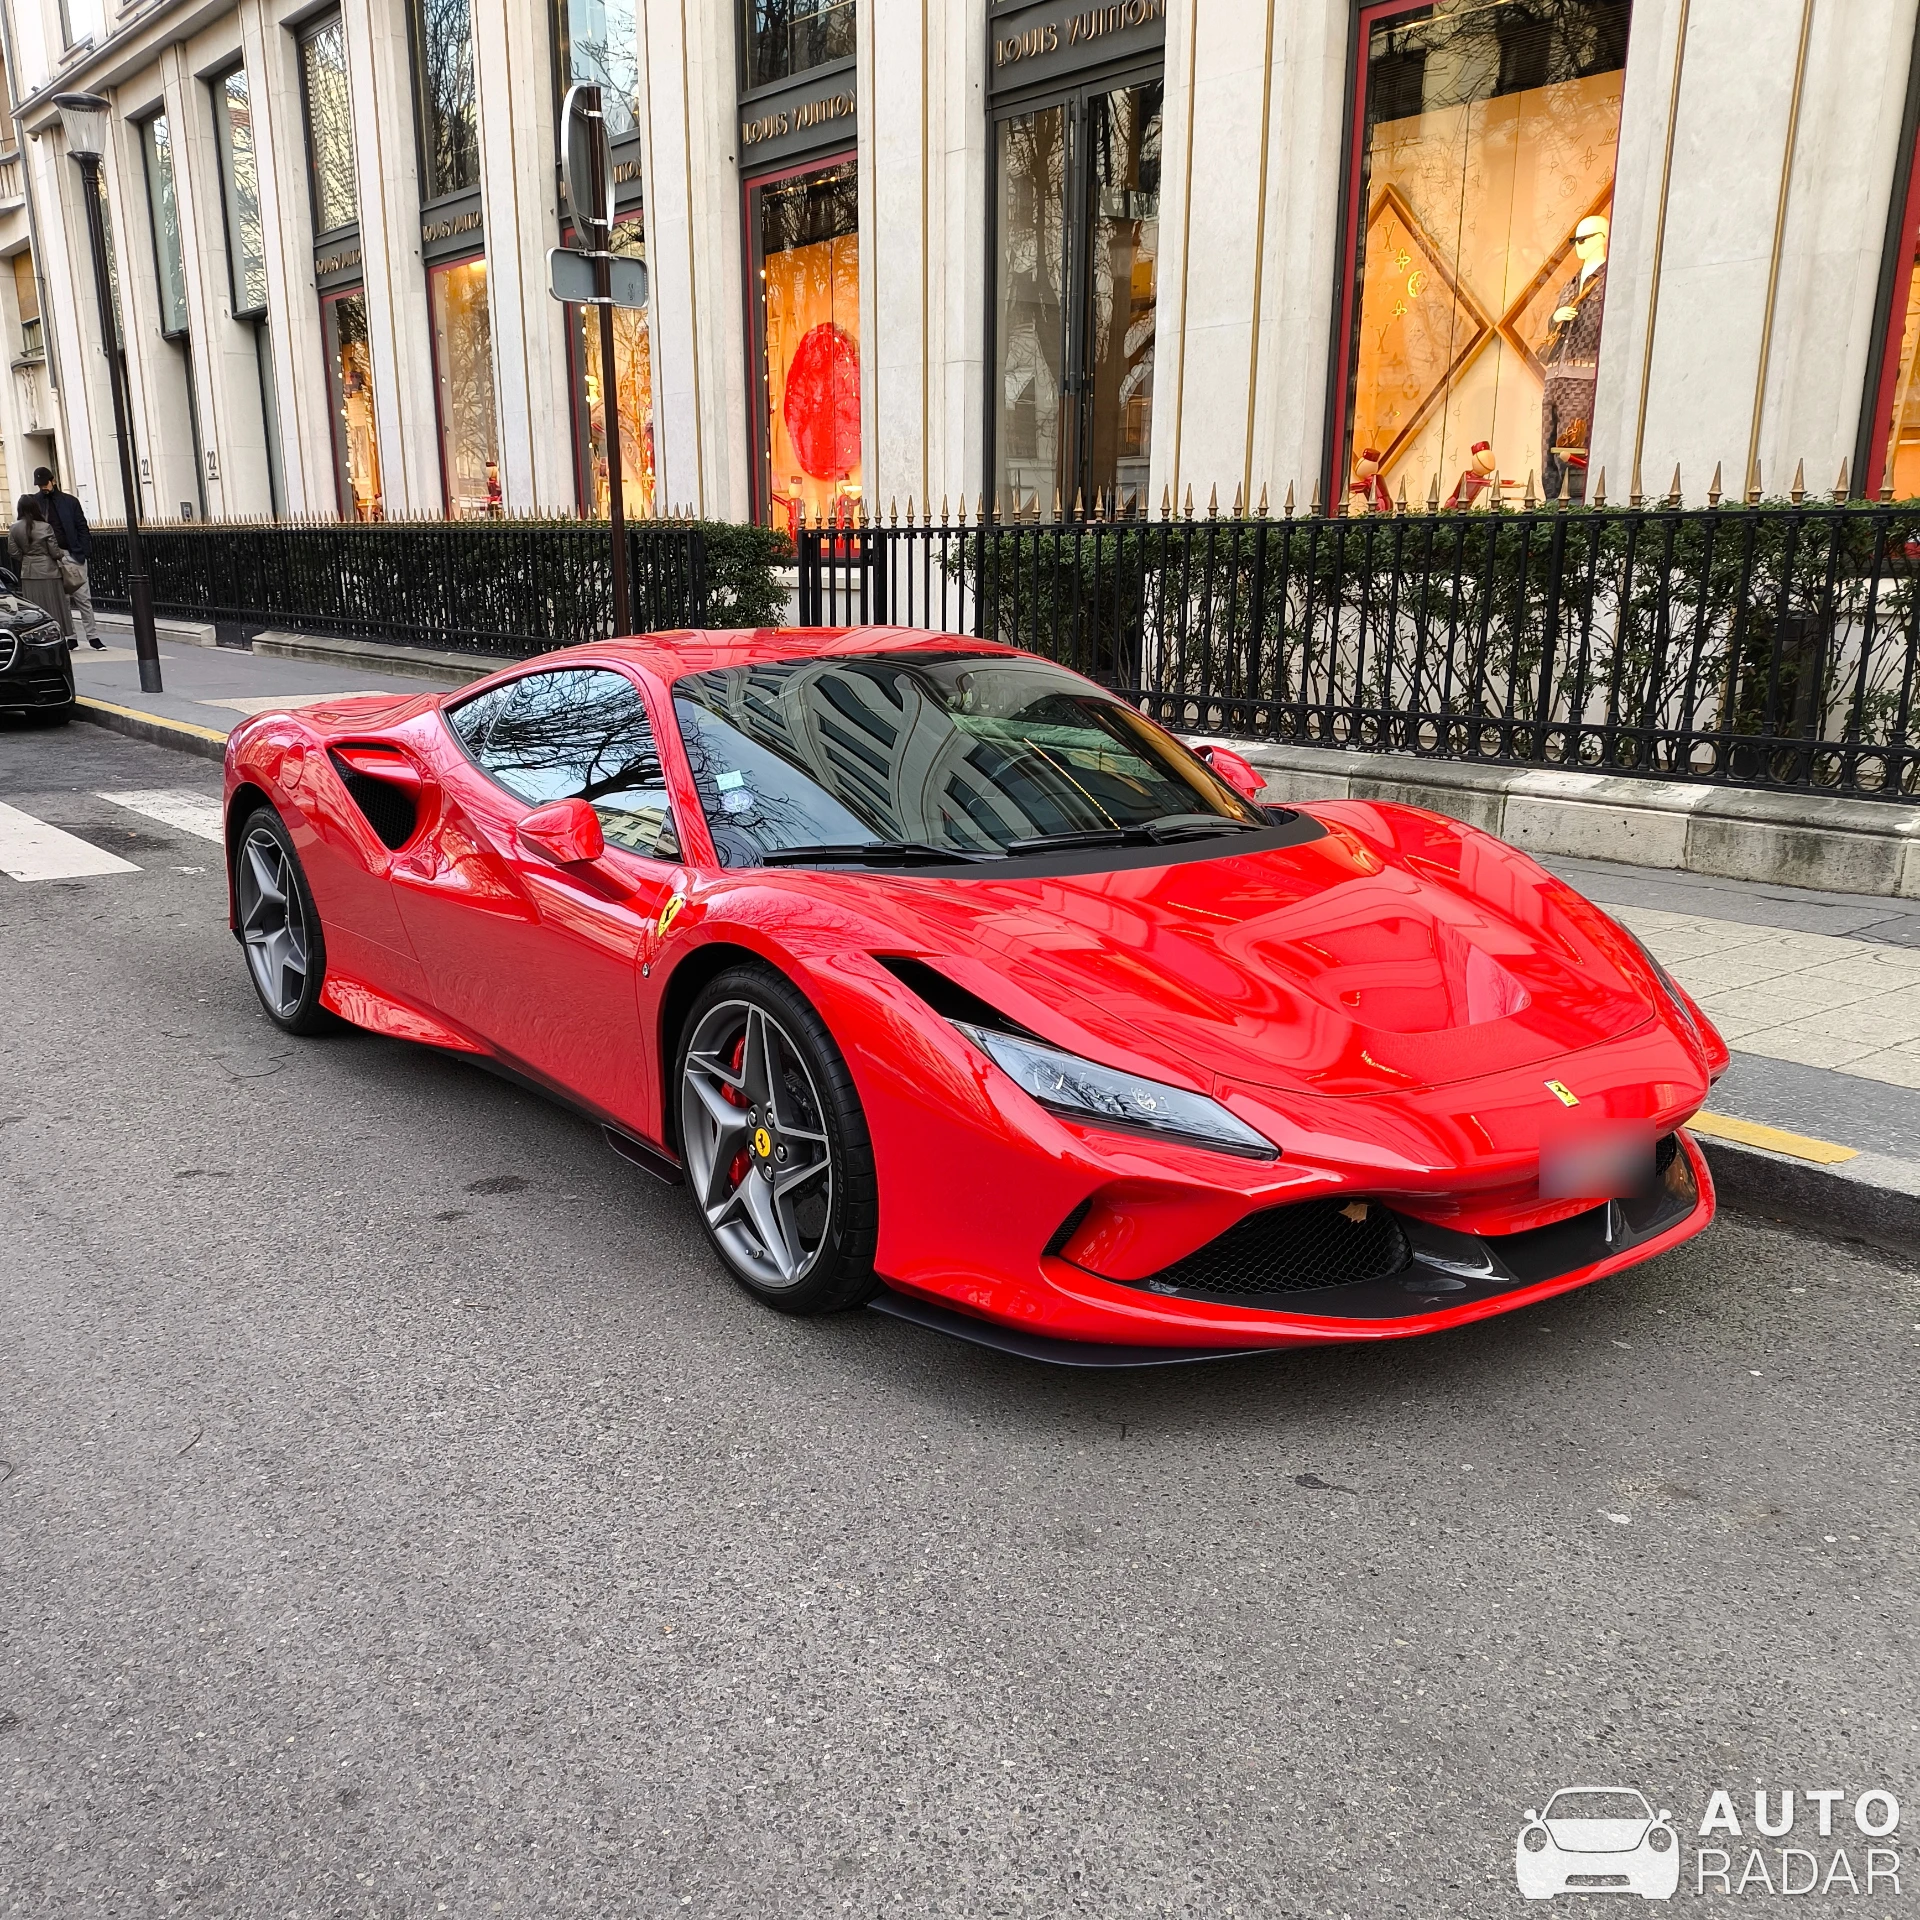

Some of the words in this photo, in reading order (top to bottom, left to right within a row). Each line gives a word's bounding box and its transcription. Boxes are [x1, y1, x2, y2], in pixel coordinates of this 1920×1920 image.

[995, 22, 1058, 67] LOUIS
[1064, 0, 1166, 46] VUITTON
[742, 111, 788, 145] LOUIS
